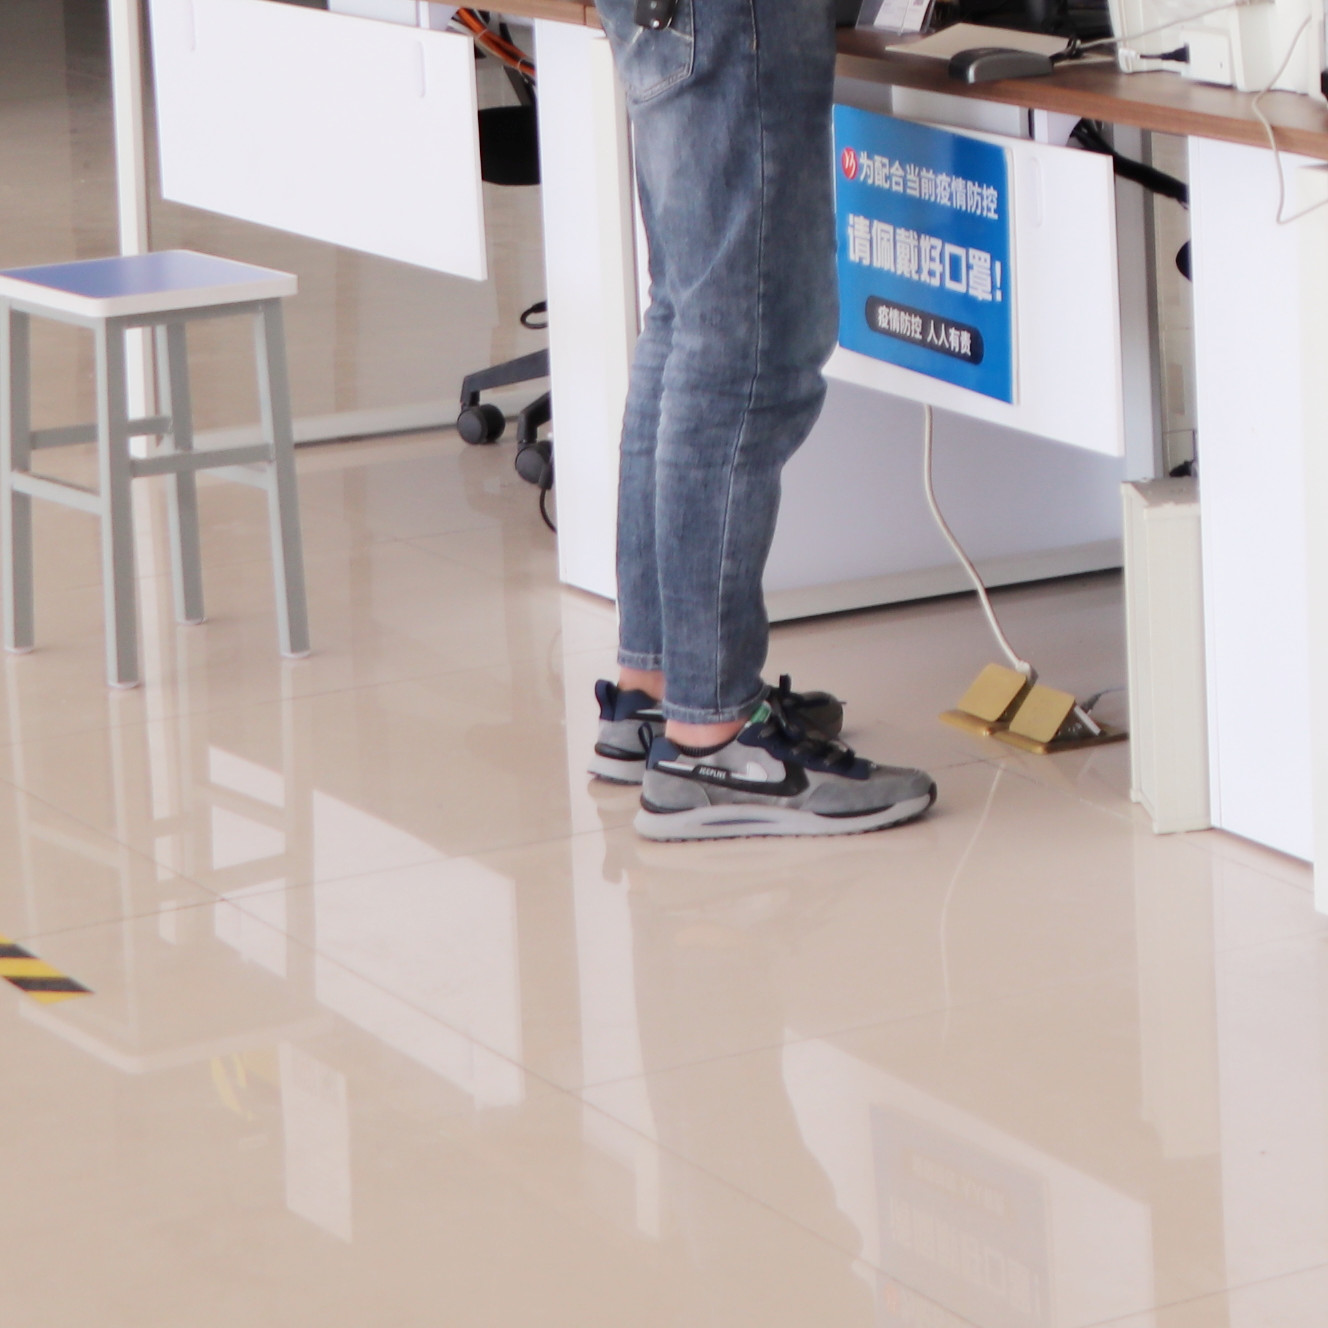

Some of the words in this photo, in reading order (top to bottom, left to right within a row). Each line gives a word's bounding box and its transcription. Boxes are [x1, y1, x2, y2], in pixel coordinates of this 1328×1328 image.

[859, 151, 998, 220] 为配合当前疫情防控
[848, 213, 1002, 302] 请佩戴好口罩!
[877, 305, 923, 340] 疫情防控
[926, 319, 972, 357] 人人有责
